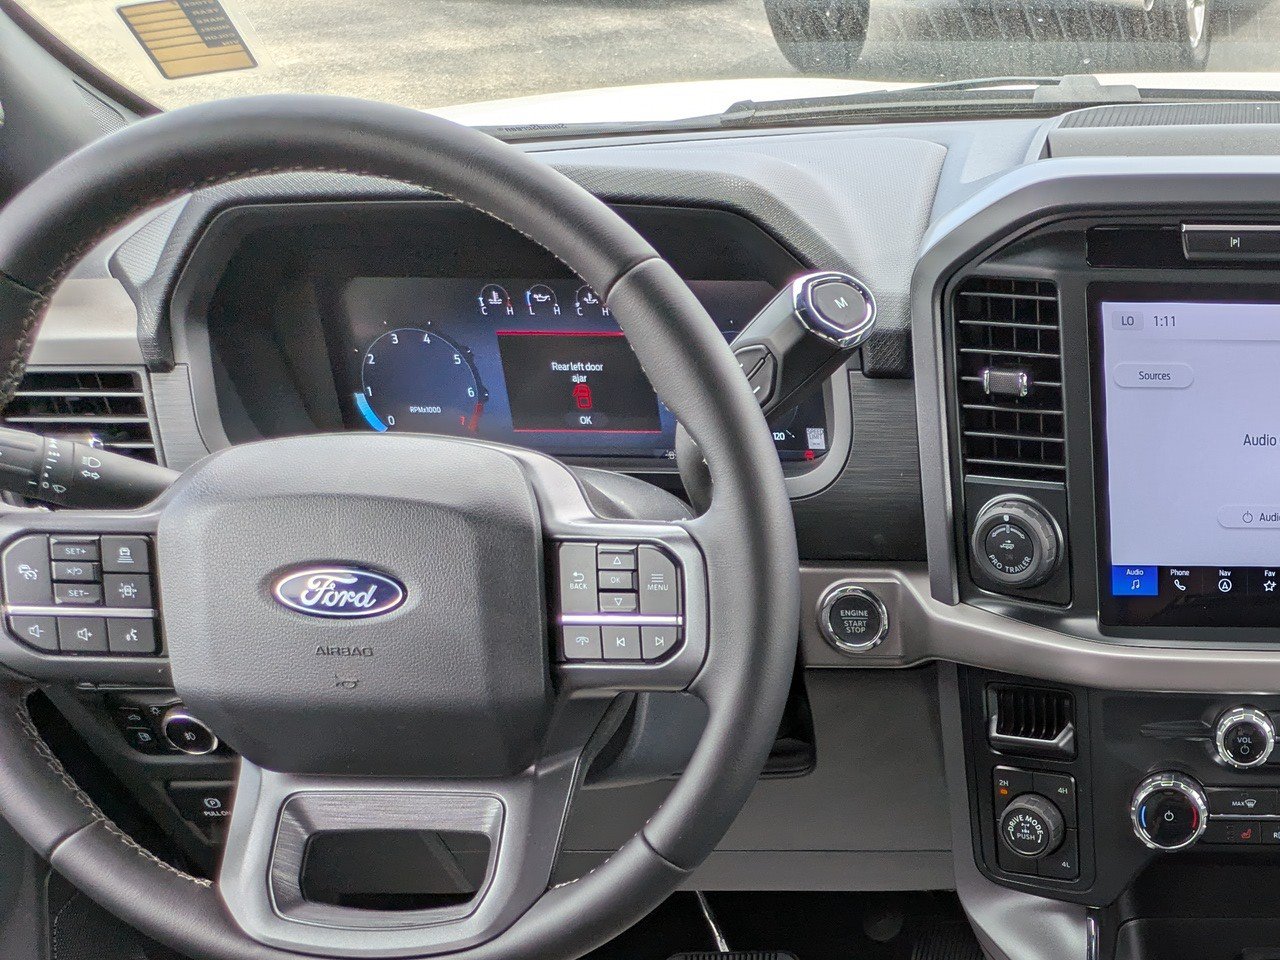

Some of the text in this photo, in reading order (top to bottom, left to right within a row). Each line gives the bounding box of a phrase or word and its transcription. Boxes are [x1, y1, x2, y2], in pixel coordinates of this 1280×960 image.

[481, 306, 488, 315] C
[506, 306, 514, 315] H
[529, 307, 536, 315] L
[553, 306, 561, 315] H
[576, 307, 584, 316] C
[602, 307, 609, 316] H
[1121, 315, 1135, 326] LO
[1153, 315, 1176, 327] 1:11
[390, 333, 399, 344] 3
[423, 333, 431, 344] 4
[367, 353, 375, 365] 2
[453, 354, 461, 365] 5
[552, 361, 603, 371] Rear left door
[572, 374, 587, 384] ajar
[1138, 370, 1171, 381] Sources
[366, 386, 373, 397] 1
[467, 387, 475, 398] 6
[387, 415, 395, 426] 0
[579, 416, 593, 425] OK
[772, 431, 786, 441] 120
[1242, 433, 1277, 447] Audio
[65, 547, 87, 555] SET+
[988, 554, 1032, 573] PRO TRAILER
[1125, 568, 1144, 576] Audio
[1170, 569, 1190, 577] Phone
[1218, 569, 1232, 577] Nav
[1264, 569, 1276, 577] Fav
[610, 576, 621, 584] OK
[300, 574, 378, 608] Ford
[840, 609, 869, 617] ENGINE
[846, 626, 866, 634] STOP
[315, 646, 374, 657] AIRBAG
[1237, 736, 1252, 744] VOL
[999, 779, 1009, 787] 2H
[1007, 814, 1044, 835] DRIVE MODE
[1016, 833, 1036, 841] PUSH
